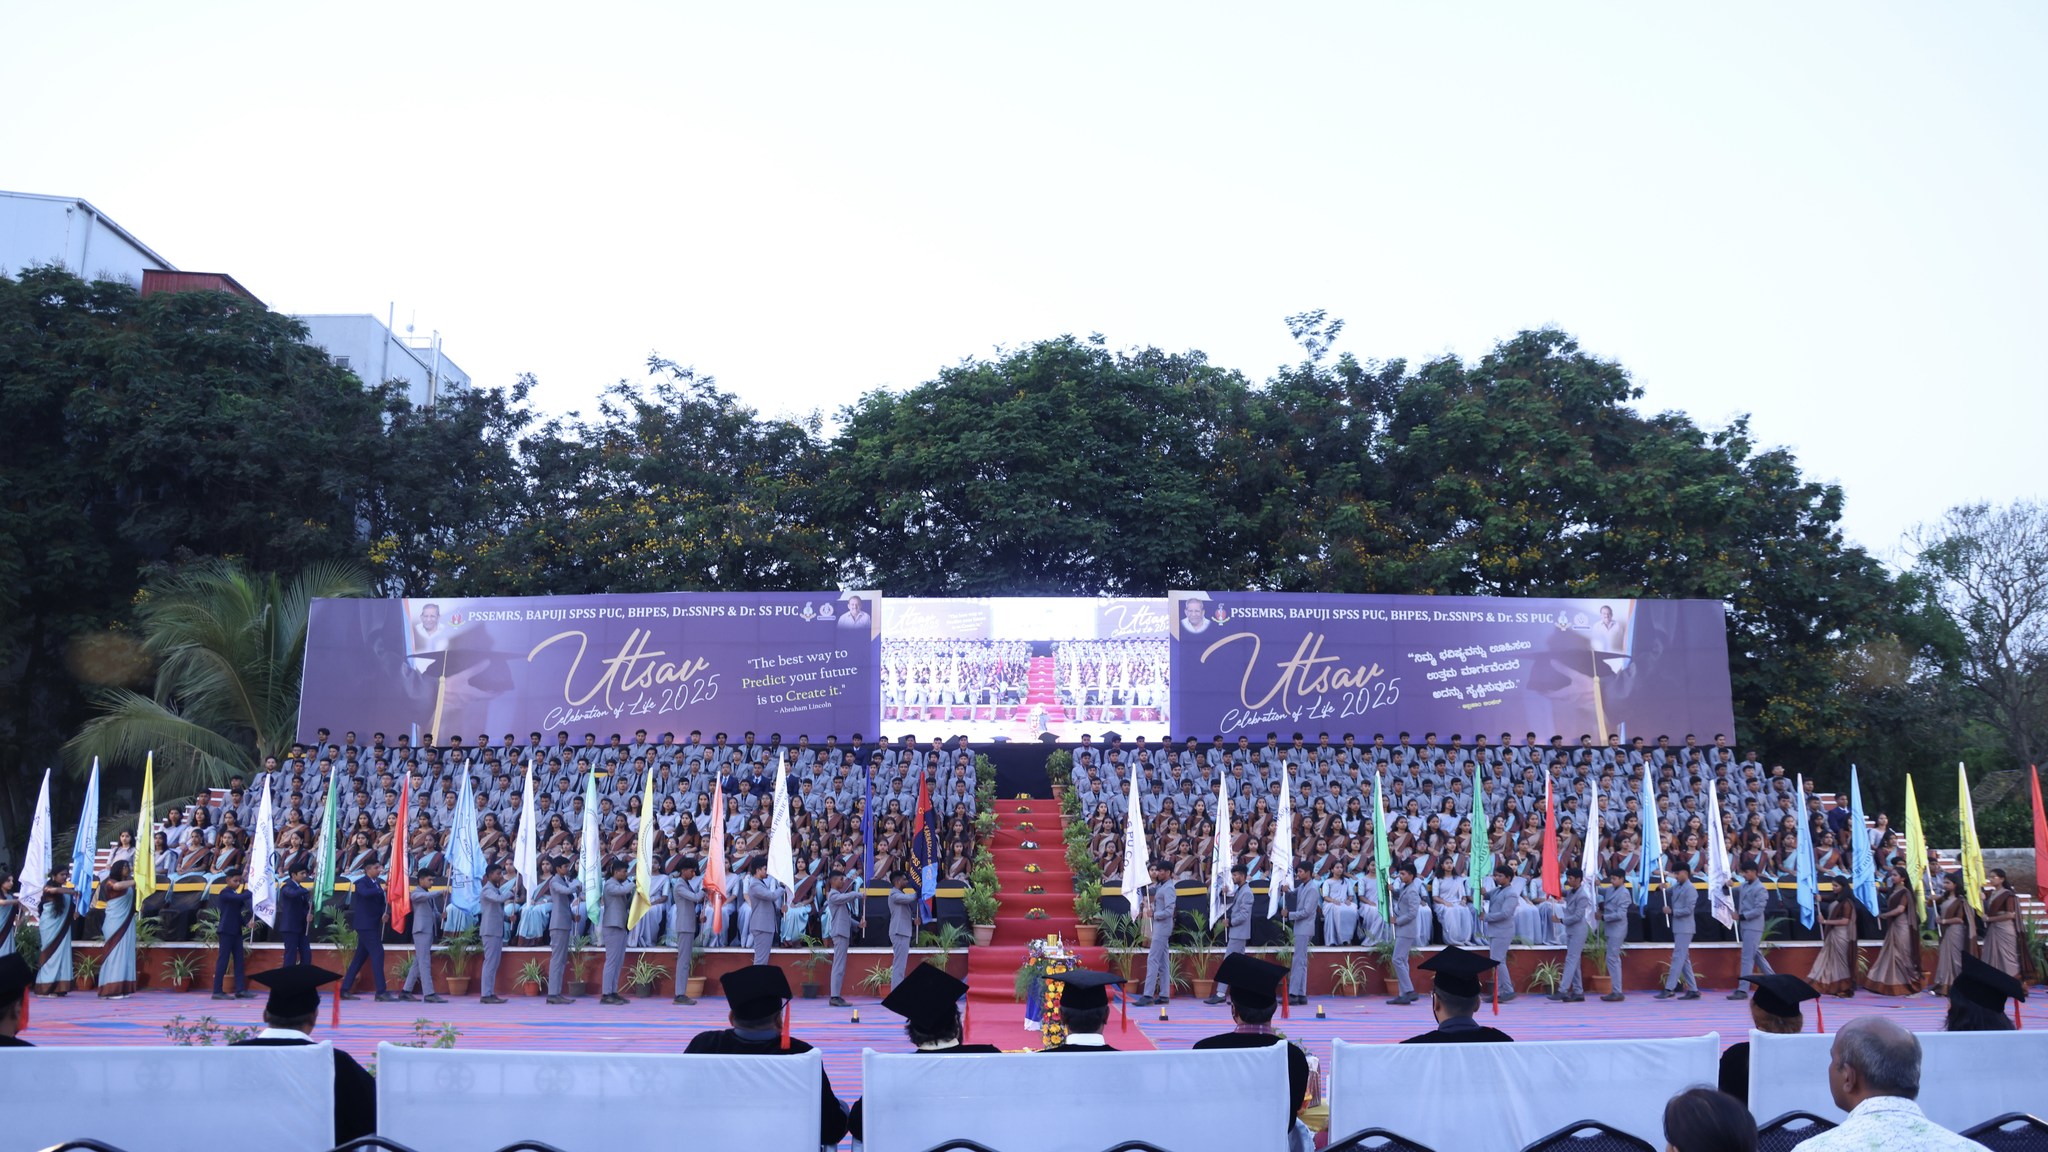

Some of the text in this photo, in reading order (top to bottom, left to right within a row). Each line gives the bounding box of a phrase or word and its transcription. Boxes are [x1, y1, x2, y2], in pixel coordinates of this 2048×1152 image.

[468, 606, 799, 622] PSSEMRS, BAPUJI SPSS PUC, BHPES, Dr.SSNPS & Dr. SS PUC
[1230, 607, 1554, 624] PSSEMRS, BAPUJI SPSS PUC, BHPES, Dr.SSNPS & Dr. SS PUC
[528, 628, 710, 711] Utsav
[748, 649, 848, 670] "The best way to
[742, 666, 858, 688] Predict your future
[1200, 631, 1384, 715] Utsav
[1426, 668, 1457, 682] ಉತ್ತಮ
[543, 674, 720, 730] Celebration of Life 2025
[756, 684, 846, 706] is to Create it."
[1432, 686, 1464, 700] ಅದನ್ನು
[780, 705, 808, 714] Abraham
[808, 702, 832, 710] Lincoln
[1220, 678, 1401, 734] Celebration of Life 2025
